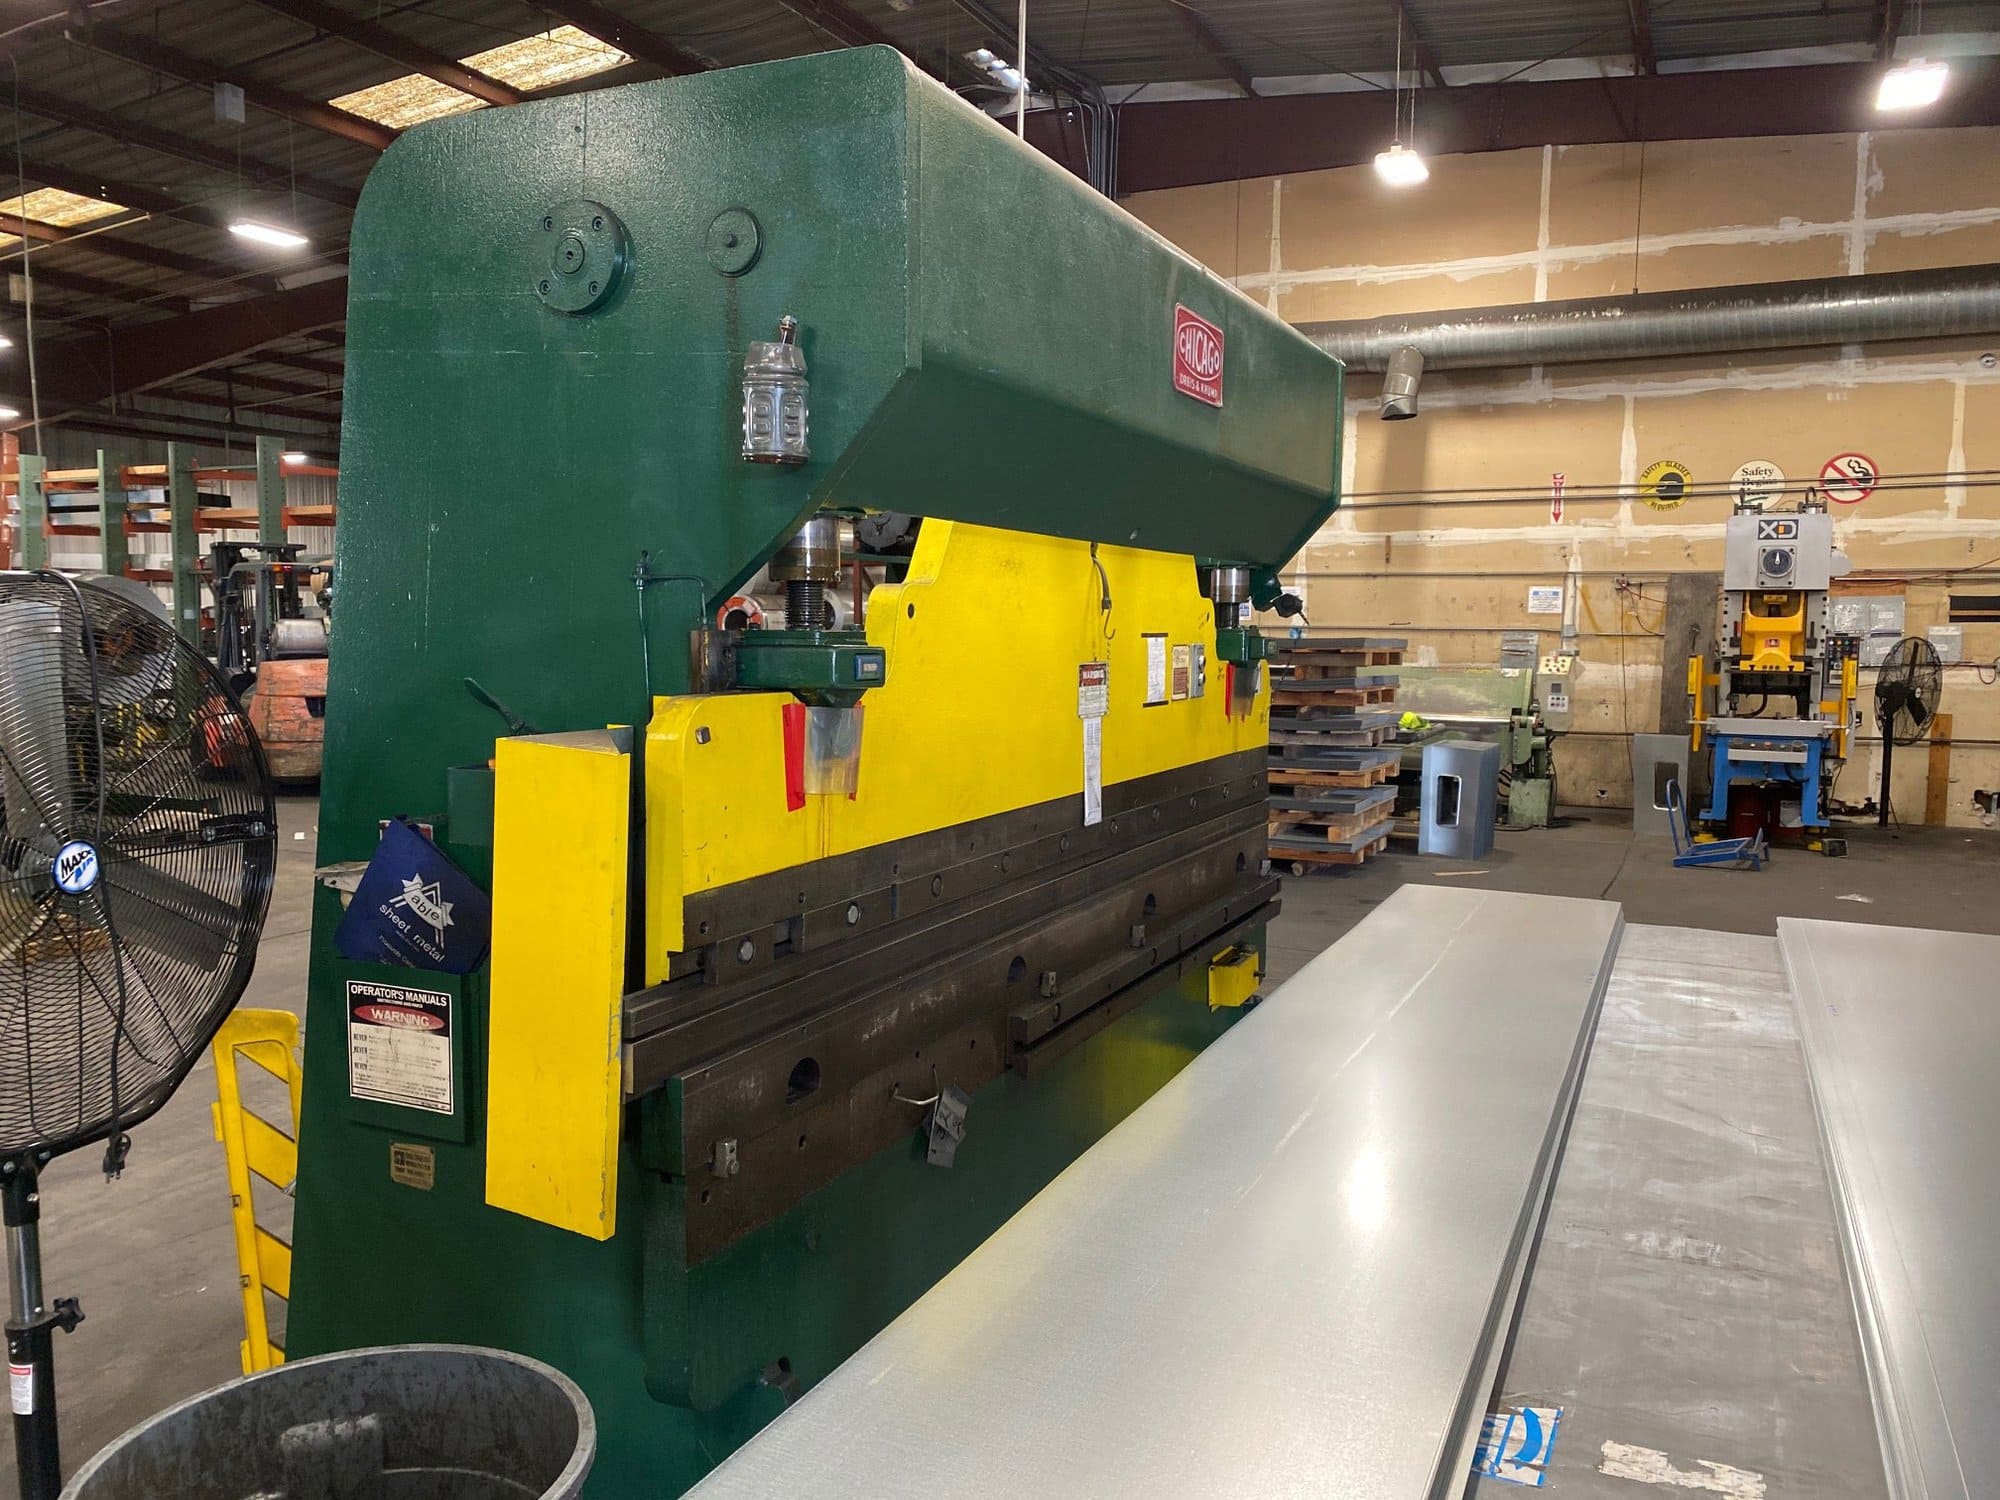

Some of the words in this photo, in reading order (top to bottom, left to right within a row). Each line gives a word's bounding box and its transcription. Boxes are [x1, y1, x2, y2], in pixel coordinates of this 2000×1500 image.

[1180, 328, 1220, 374] CHICAGO
[1741, 467, 1774, 476] Safety
[411, 894, 440, 921] able
[379, 904, 411, 934] sheet
[413, 934, 446, 963] metal
[350, 984, 404, 1000] OPERATOR'S
[405, 991, 448, 1007] MANUALS
[370, 1007, 430, 1027] WARNING
